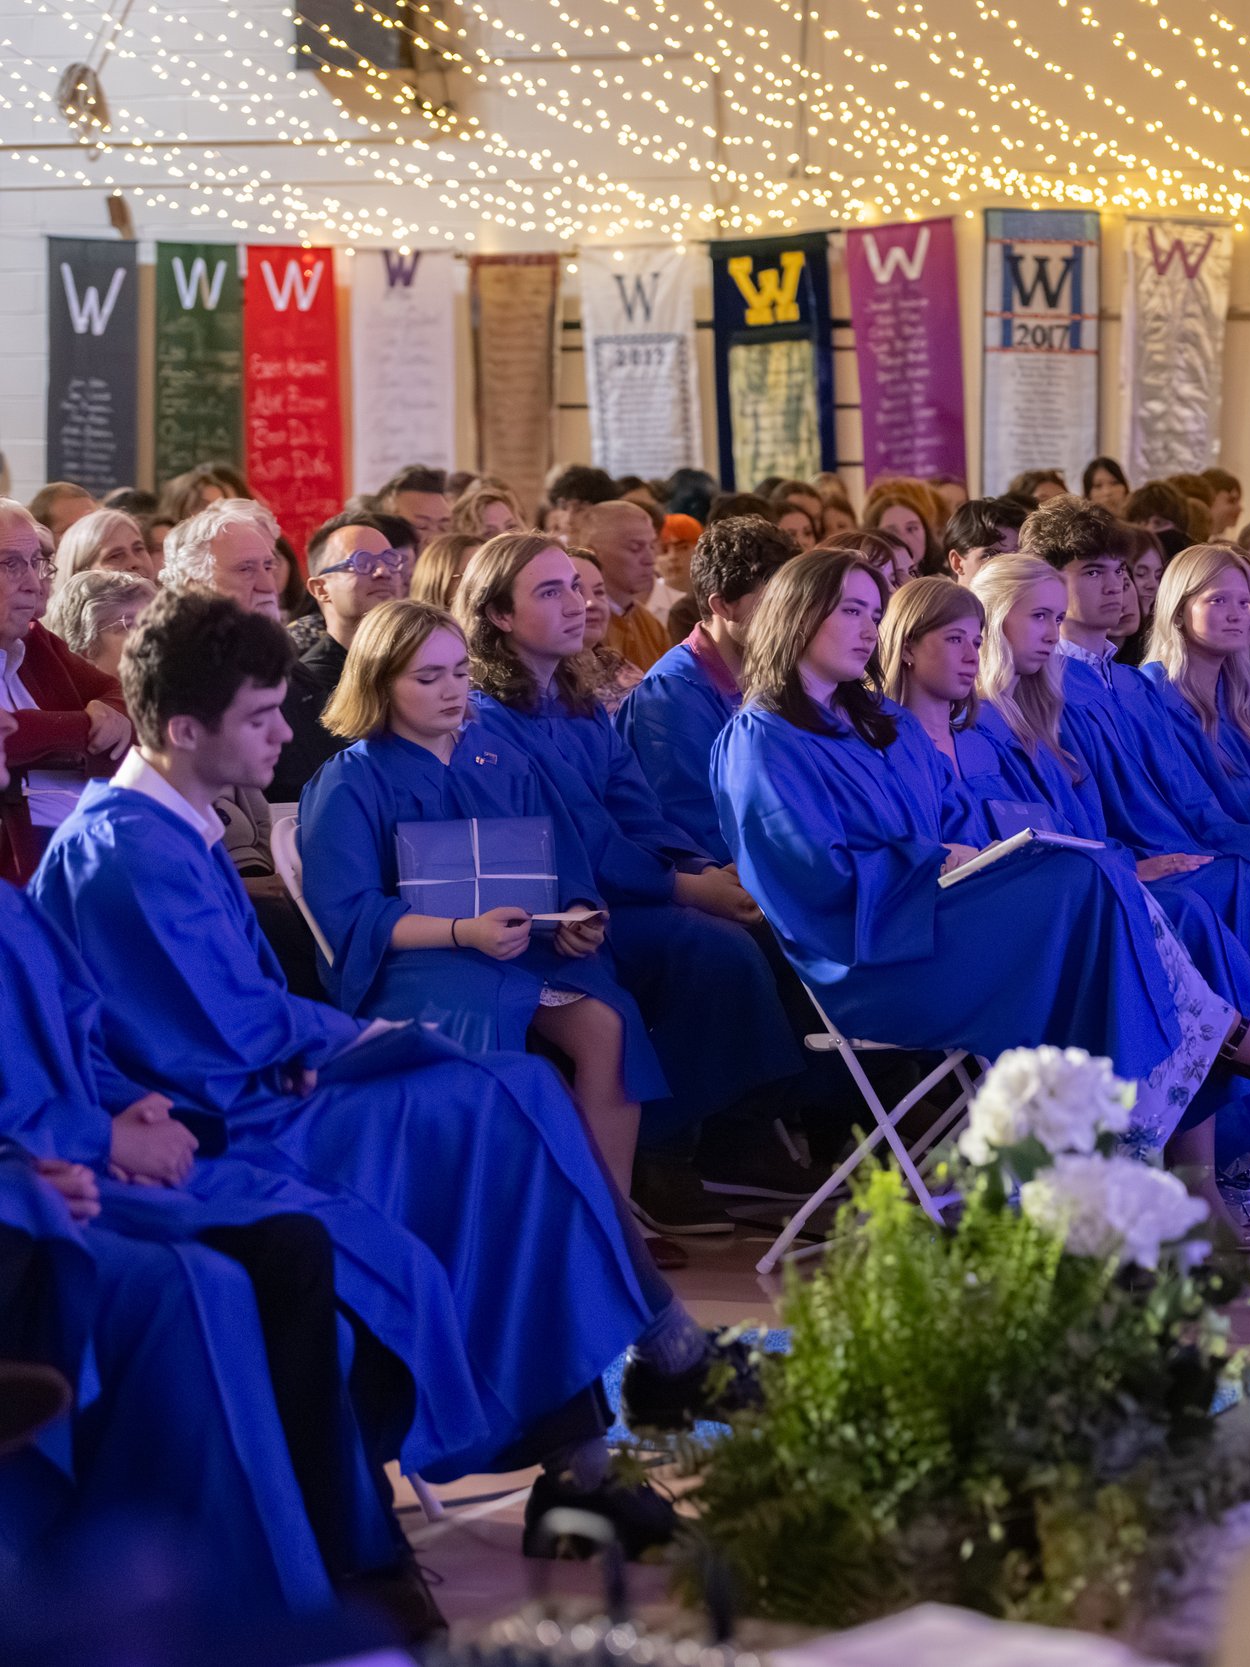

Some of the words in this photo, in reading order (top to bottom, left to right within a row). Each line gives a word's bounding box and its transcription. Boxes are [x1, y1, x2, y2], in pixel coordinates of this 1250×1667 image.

[381, 248, 421, 288] W
[862, 226, 931, 284] W
[1147, 226, 1215, 280] W
[60, 261, 127, 336] W
[171, 256, 228, 311] W
[260, 259, 325, 312] W
[611, 271, 661, 323] W
[727, 250, 806, 326] W
[1006, 254, 1078, 309] W
[1016, 323, 1071, 349] 2017
